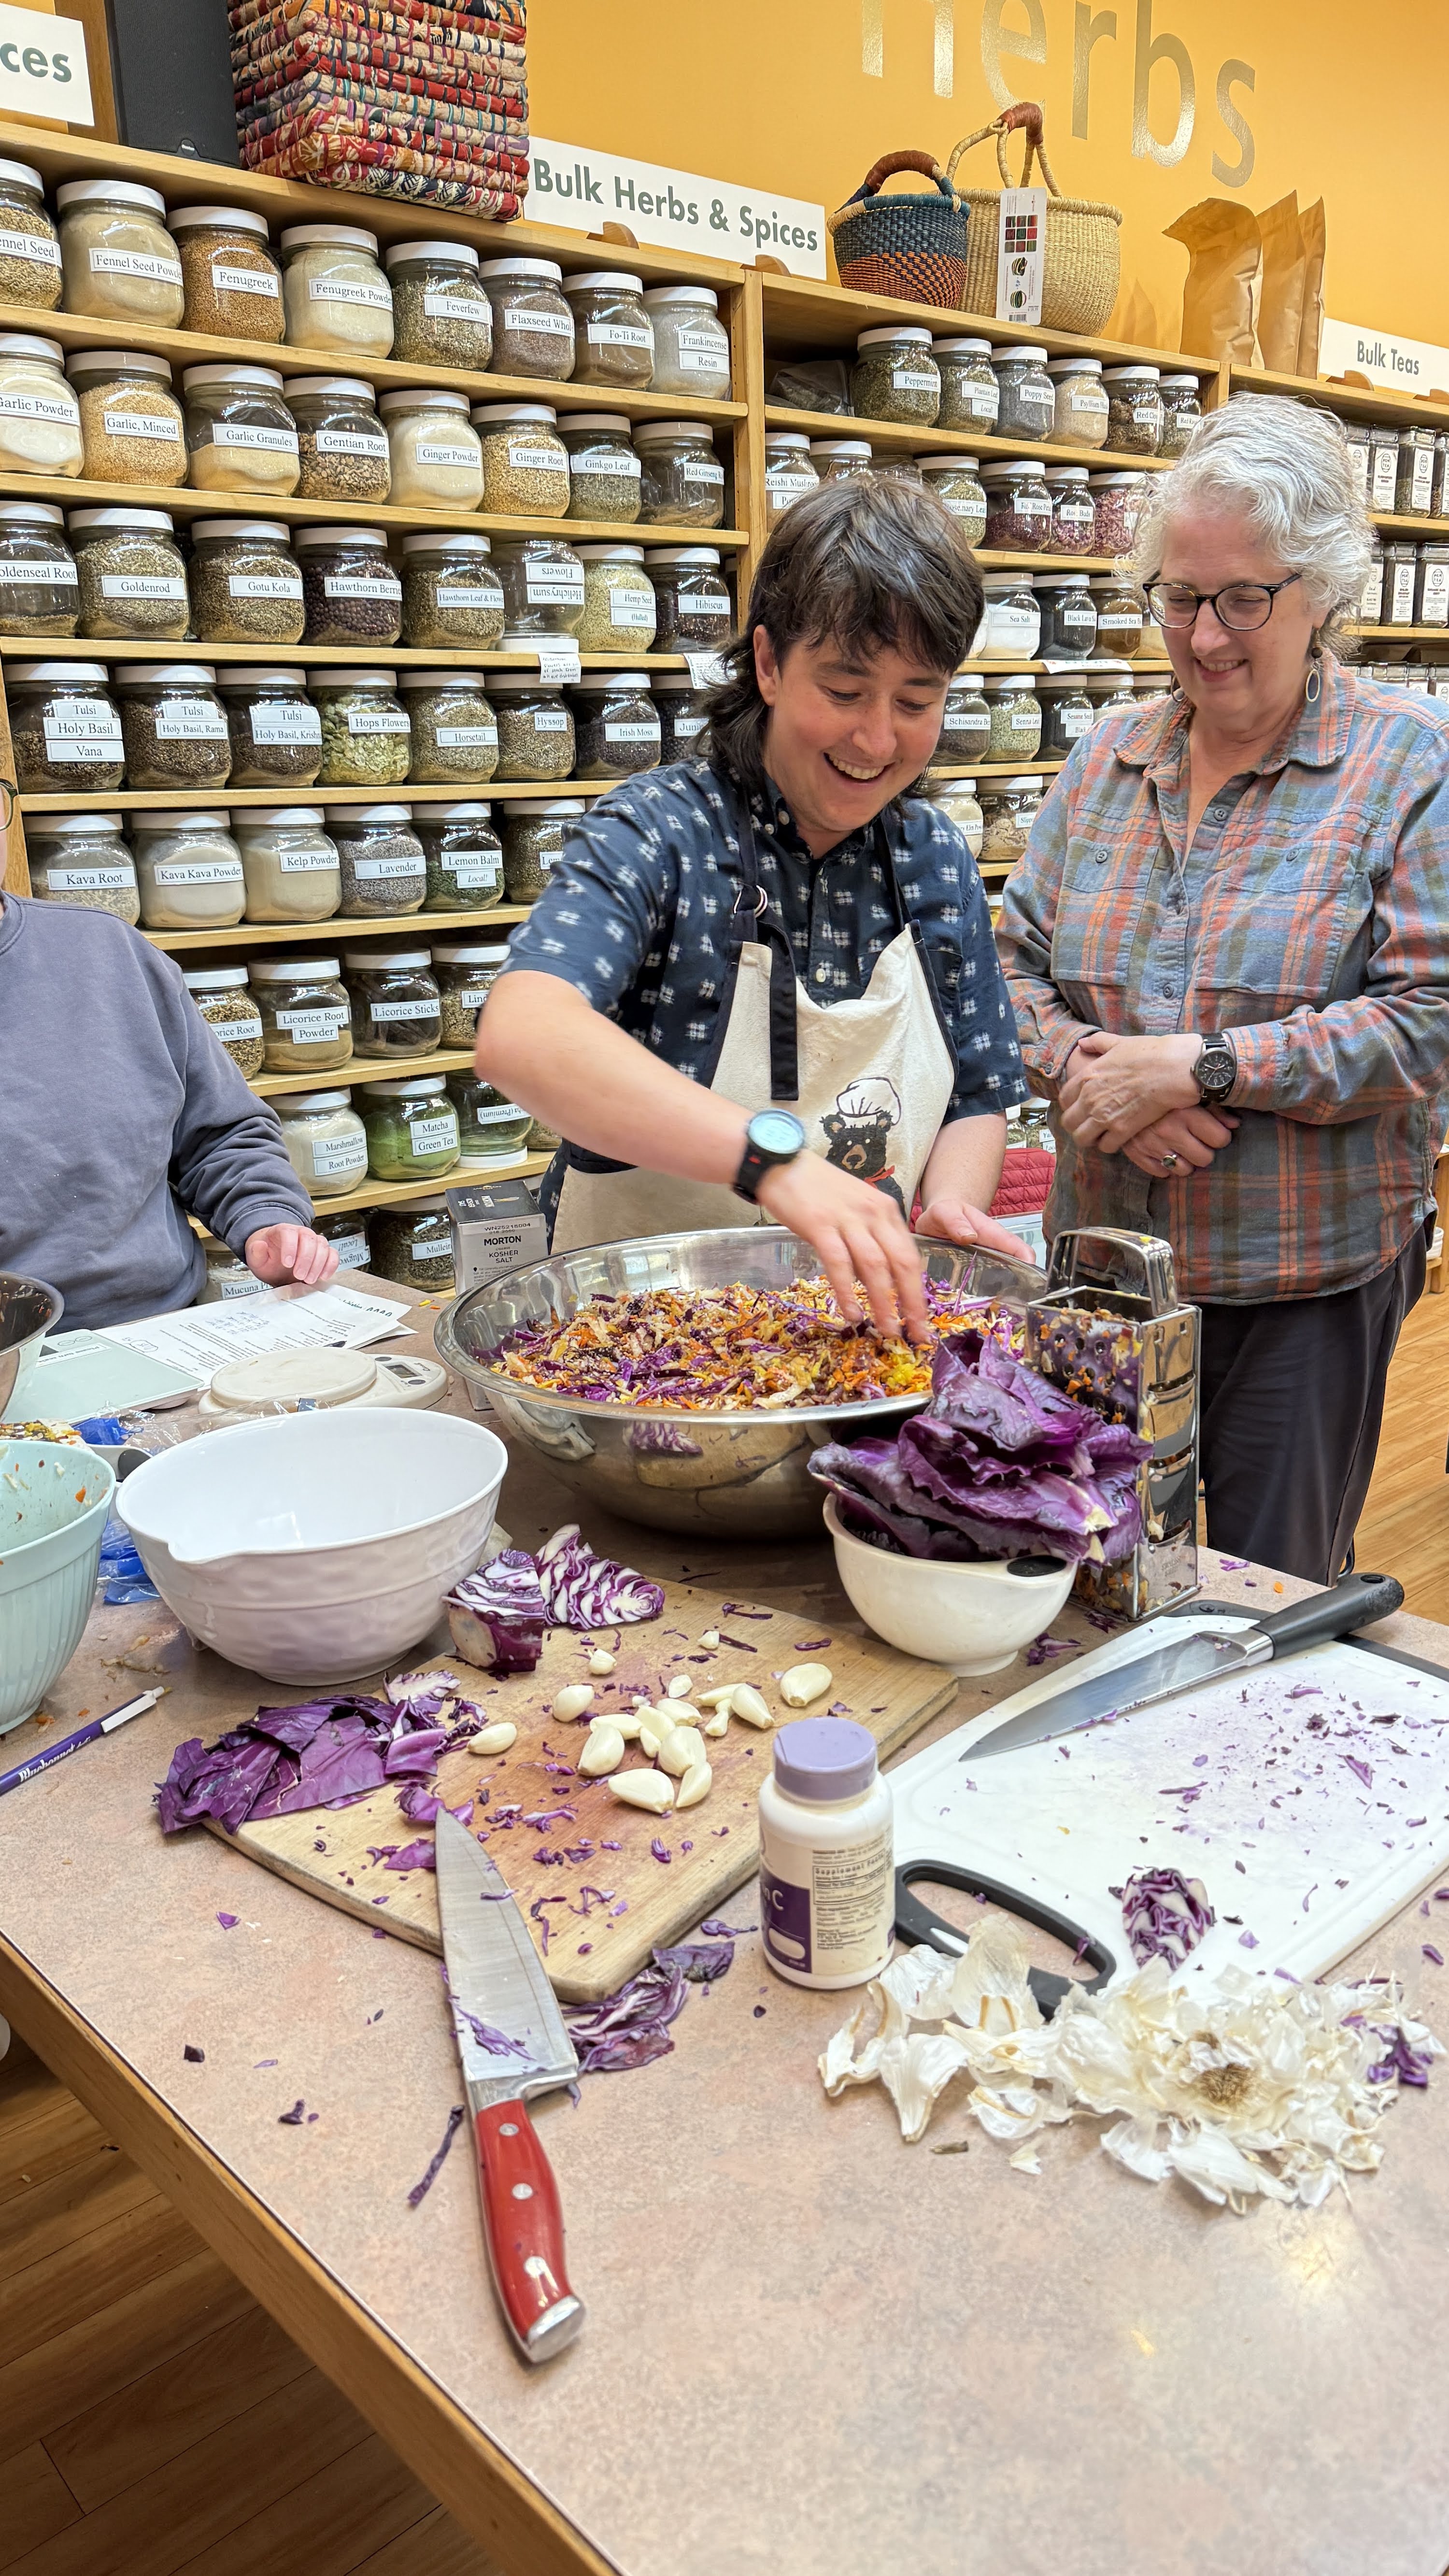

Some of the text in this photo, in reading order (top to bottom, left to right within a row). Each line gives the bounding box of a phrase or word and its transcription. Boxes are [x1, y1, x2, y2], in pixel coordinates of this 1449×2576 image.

[534, 157, 818, 251] Bulk Herbs & Spices
[30, 241, 55, 258] Seed
[96, 255, 130, 269] Fennel
[133, 258, 155, 273] Seed
[219, 271, 273, 291] Fenugreek
[316, 284, 366, 299] Fenugreek
[446, 301, 480, 315] Feverfew
[511, 314, 551, 328] Flaxseed
[610, 329, 646, 343] Fo-Ti Root
[683, 335, 727, 350] Frankincense
[698, 356, 717, 368] Resin
[1357, 340, 1420, 375] Bulk Teas
[905, 375, 938, 389] Peppermint
[1024, 389, 1042, 400] Poppy
[35, 402, 74, 418] Powder
[107, 417, 176, 434] Garlic, Minced
[226, 430, 293, 447] Garlic Granules
[324, 436, 386, 452] Gentian Root
[423, 449, 478, 463] Ginger Powder
[516, 452, 564, 466] Ginger Root
[585, 459, 631, 472] Ginkgo Leaf
[766, 477, 787, 487] Reishi
[54, 568, 76, 579] Root
[542, 568, 573, 579] Flowers
[121, 582, 170, 593] Goldenrod
[248, 582, 290, 593] Gotu Kola
[330, 582, 377, 593] Hawthorn
[440, 594, 469, 602] Hawthorn
[470, 594, 483, 602] Leaf
[533, 588, 582, 601] Helichrysum
[625, 594, 653, 605] Hemp Seed
[695, 599, 723, 610] Hibiscus
[73, 704, 97, 715] Tulsi
[181, 706, 203, 716] Tulsi
[280, 710, 302, 721] Tulsi
[355, 718, 409, 728] Hops Flowers
[537, 717, 564, 728] Hyssop
[58, 723, 113, 738] Holy Basil
[163, 725, 224, 735] Holy Basil, Rama
[256, 729, 275, 740] Holy
[278, 729, 299, 740] Basil,
[620, 728, 653, 737] Irish Moss
[455, 733, 486, 742] Horsetail
[76, 746, 102, 756] Vana
[287, 854, 338, 866] Kelp Powder
[448, 854, 499, 866] Lemon Balm
[161, 867, 242, 880] Kava Kava Powder
[379, 862, 417, 873] Lavender
[66, 873, 123, 885] Kava Root
[468, 874, 487, 883] Local!
[374, 1003, 439, 1017] Licorice Sticks
[283, 1011, 344, 1024] Licorice Root
[237, 1025, 255, 1035] Root
[299, 1027, 334, 1039] Powder
[480, 1107, 513, 1119] (Premium)
[422, 1121, 449, 1133] Matcha
[326, 1137, 364, 1152] Marshmallow
[418, 1137, 454, 1151] Green Tea
[328, 1153, 365, 1170] Root Powder
[483, 1235, 522, 1246] MORTON
[489, 1250, 519, 1258] KOSHER
[225, 1285, 259, 1296] Mucuna
